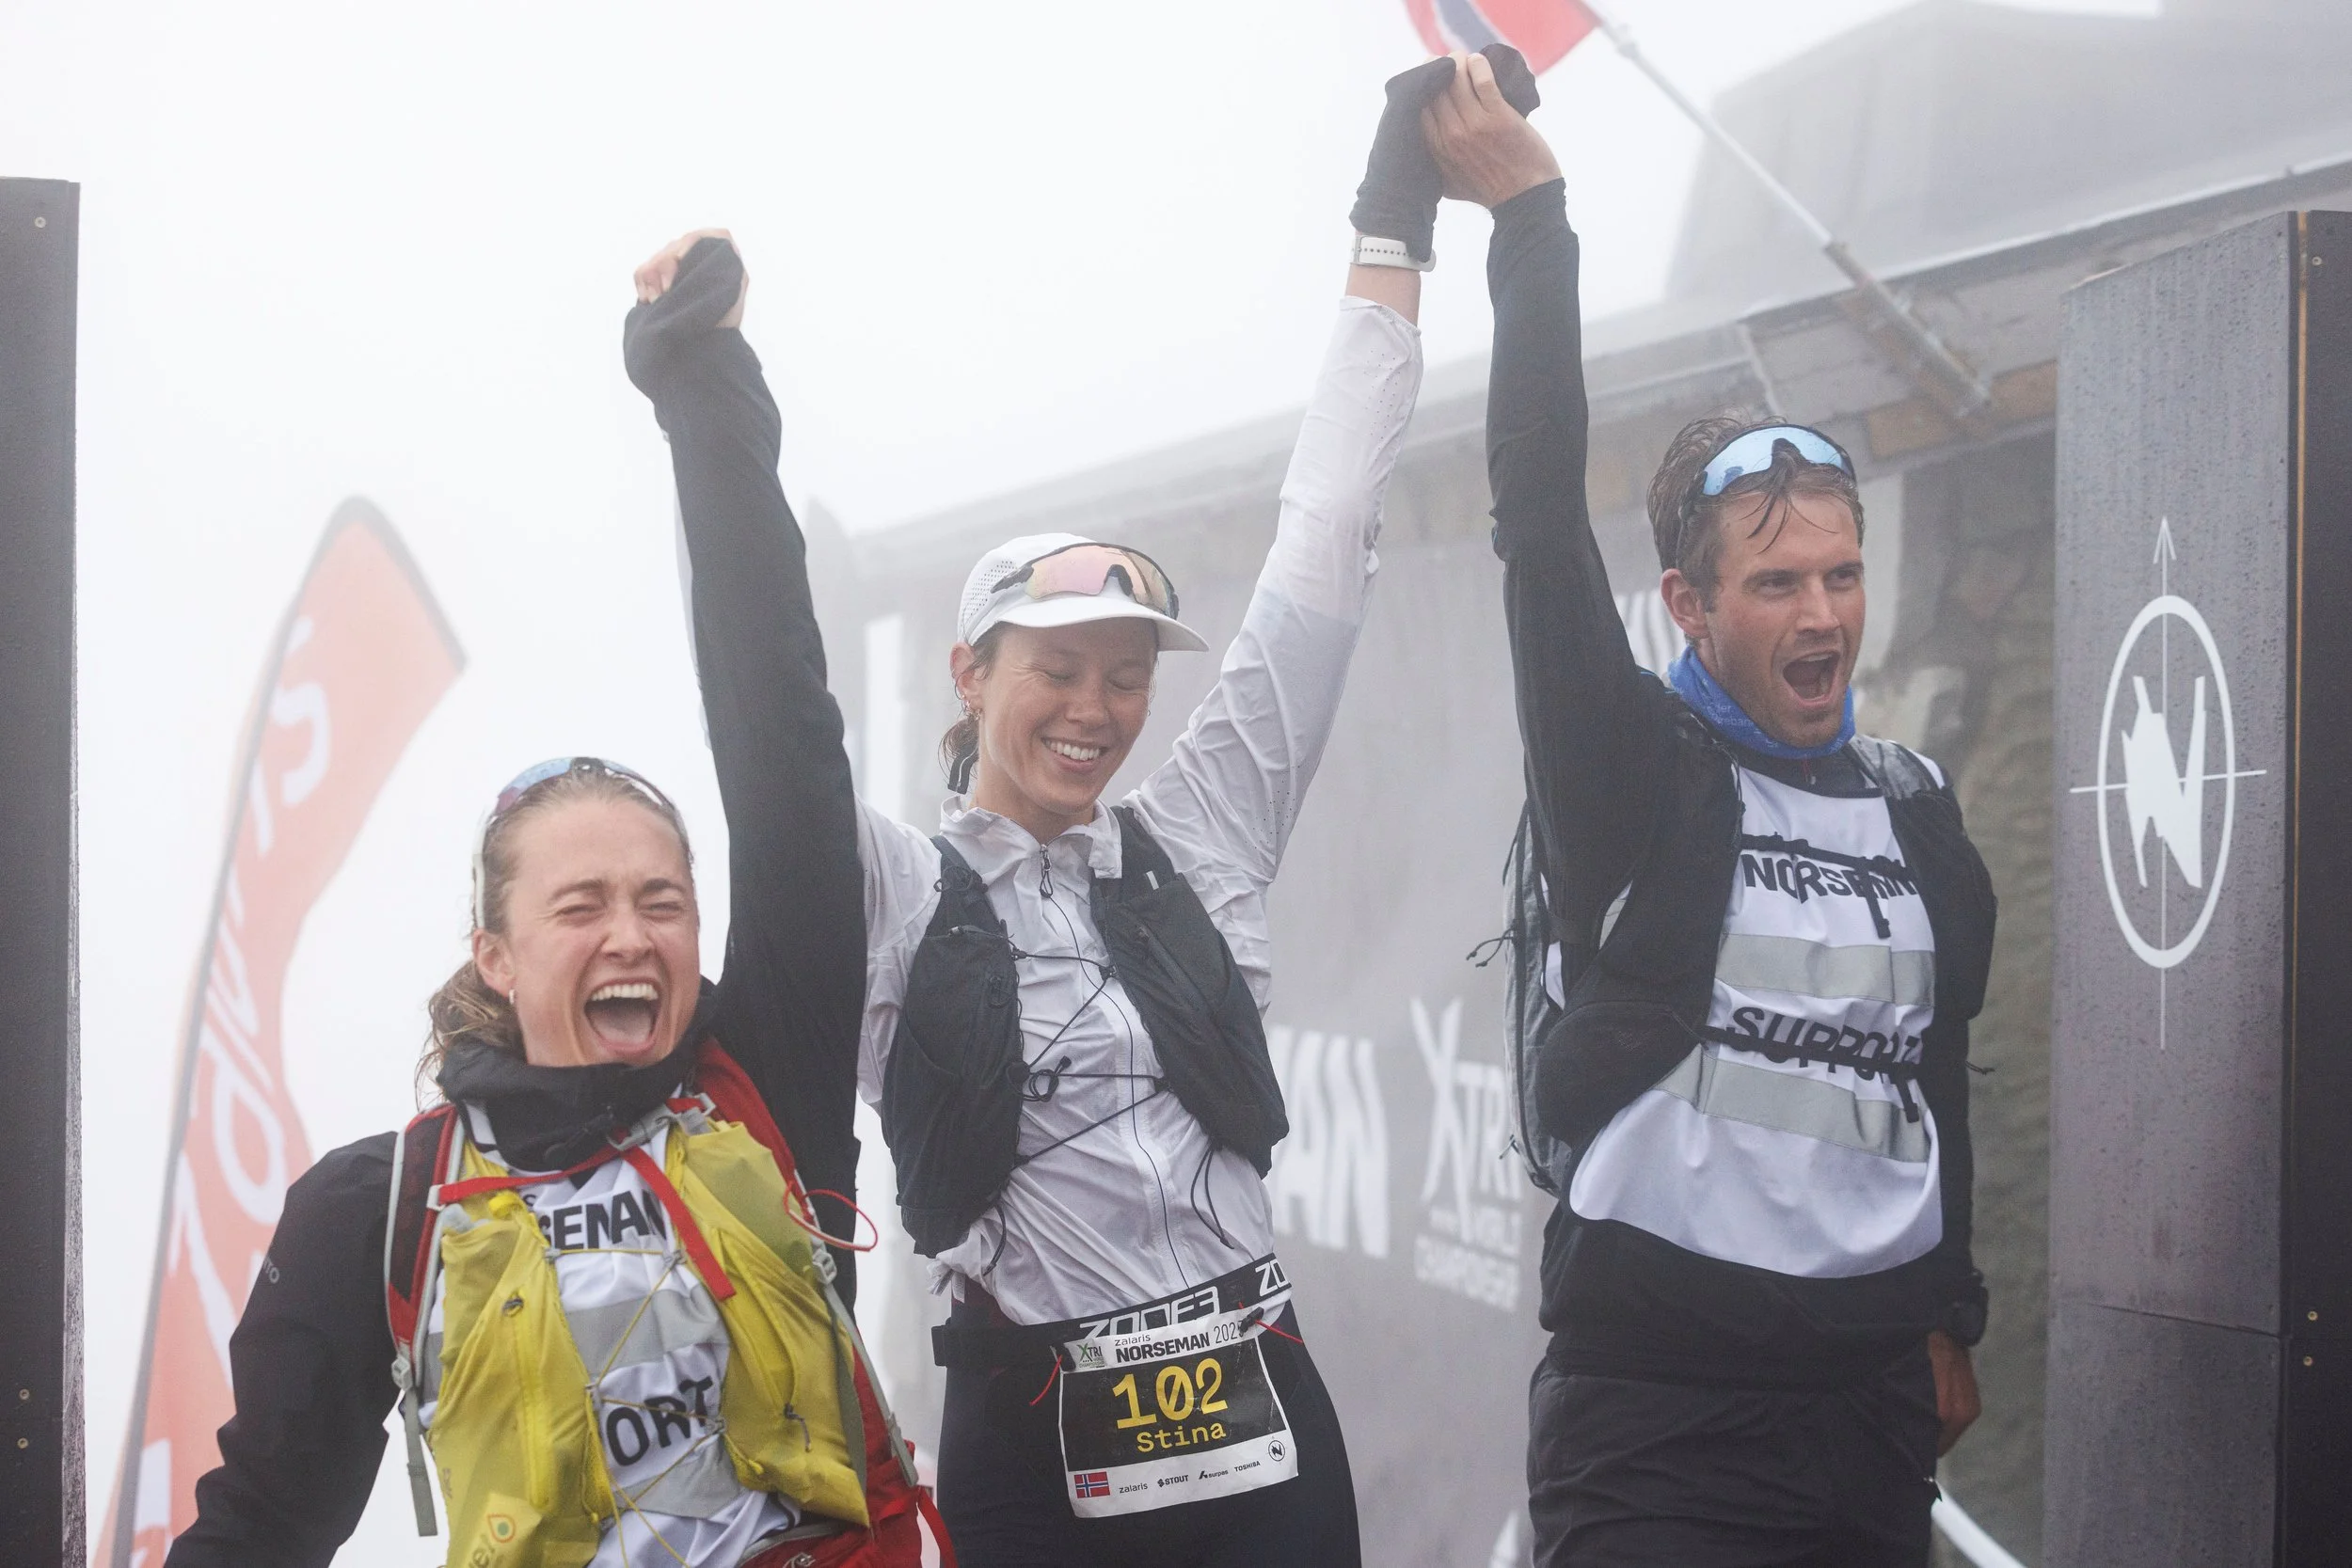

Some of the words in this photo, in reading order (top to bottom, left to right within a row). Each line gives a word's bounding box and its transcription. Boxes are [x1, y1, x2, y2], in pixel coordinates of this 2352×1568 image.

[1115, 1333, 1152, 1347] zalaris
[1116, 1332, 1211, 1364] NORSEMAN
[1112, 1357, 1229, 1430] 102
[1136, 1422, 1227, 1452] Stina
[1234, 1461, 1261, 1473] TOSHIBA
[1165, 1474, 1189, 1486] STOUT
